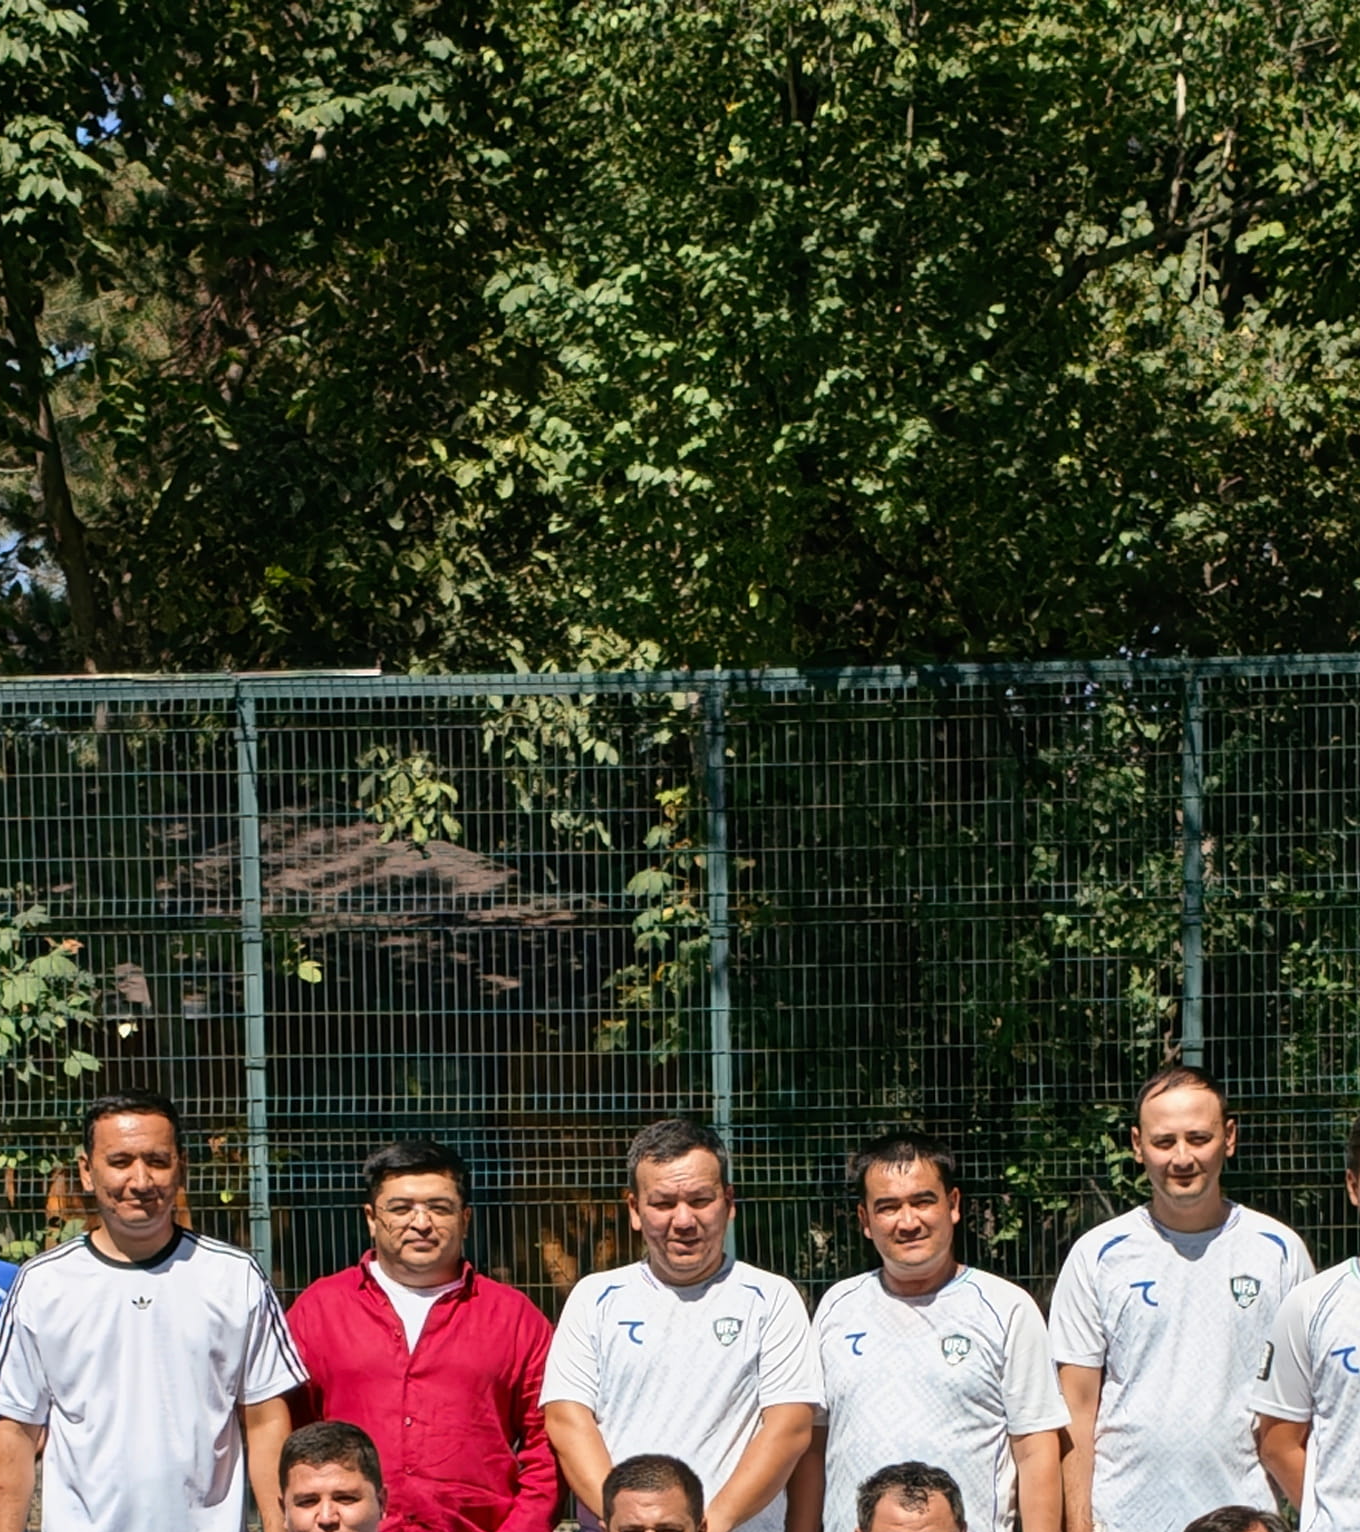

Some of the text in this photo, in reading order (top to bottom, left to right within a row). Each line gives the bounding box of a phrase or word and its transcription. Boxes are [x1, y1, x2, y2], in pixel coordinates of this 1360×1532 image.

[1233, 1279, 1257, 1296] UFA
[716, 1319, 740, 1336] UFA
[943, 1336, 968, 1354] UFA
